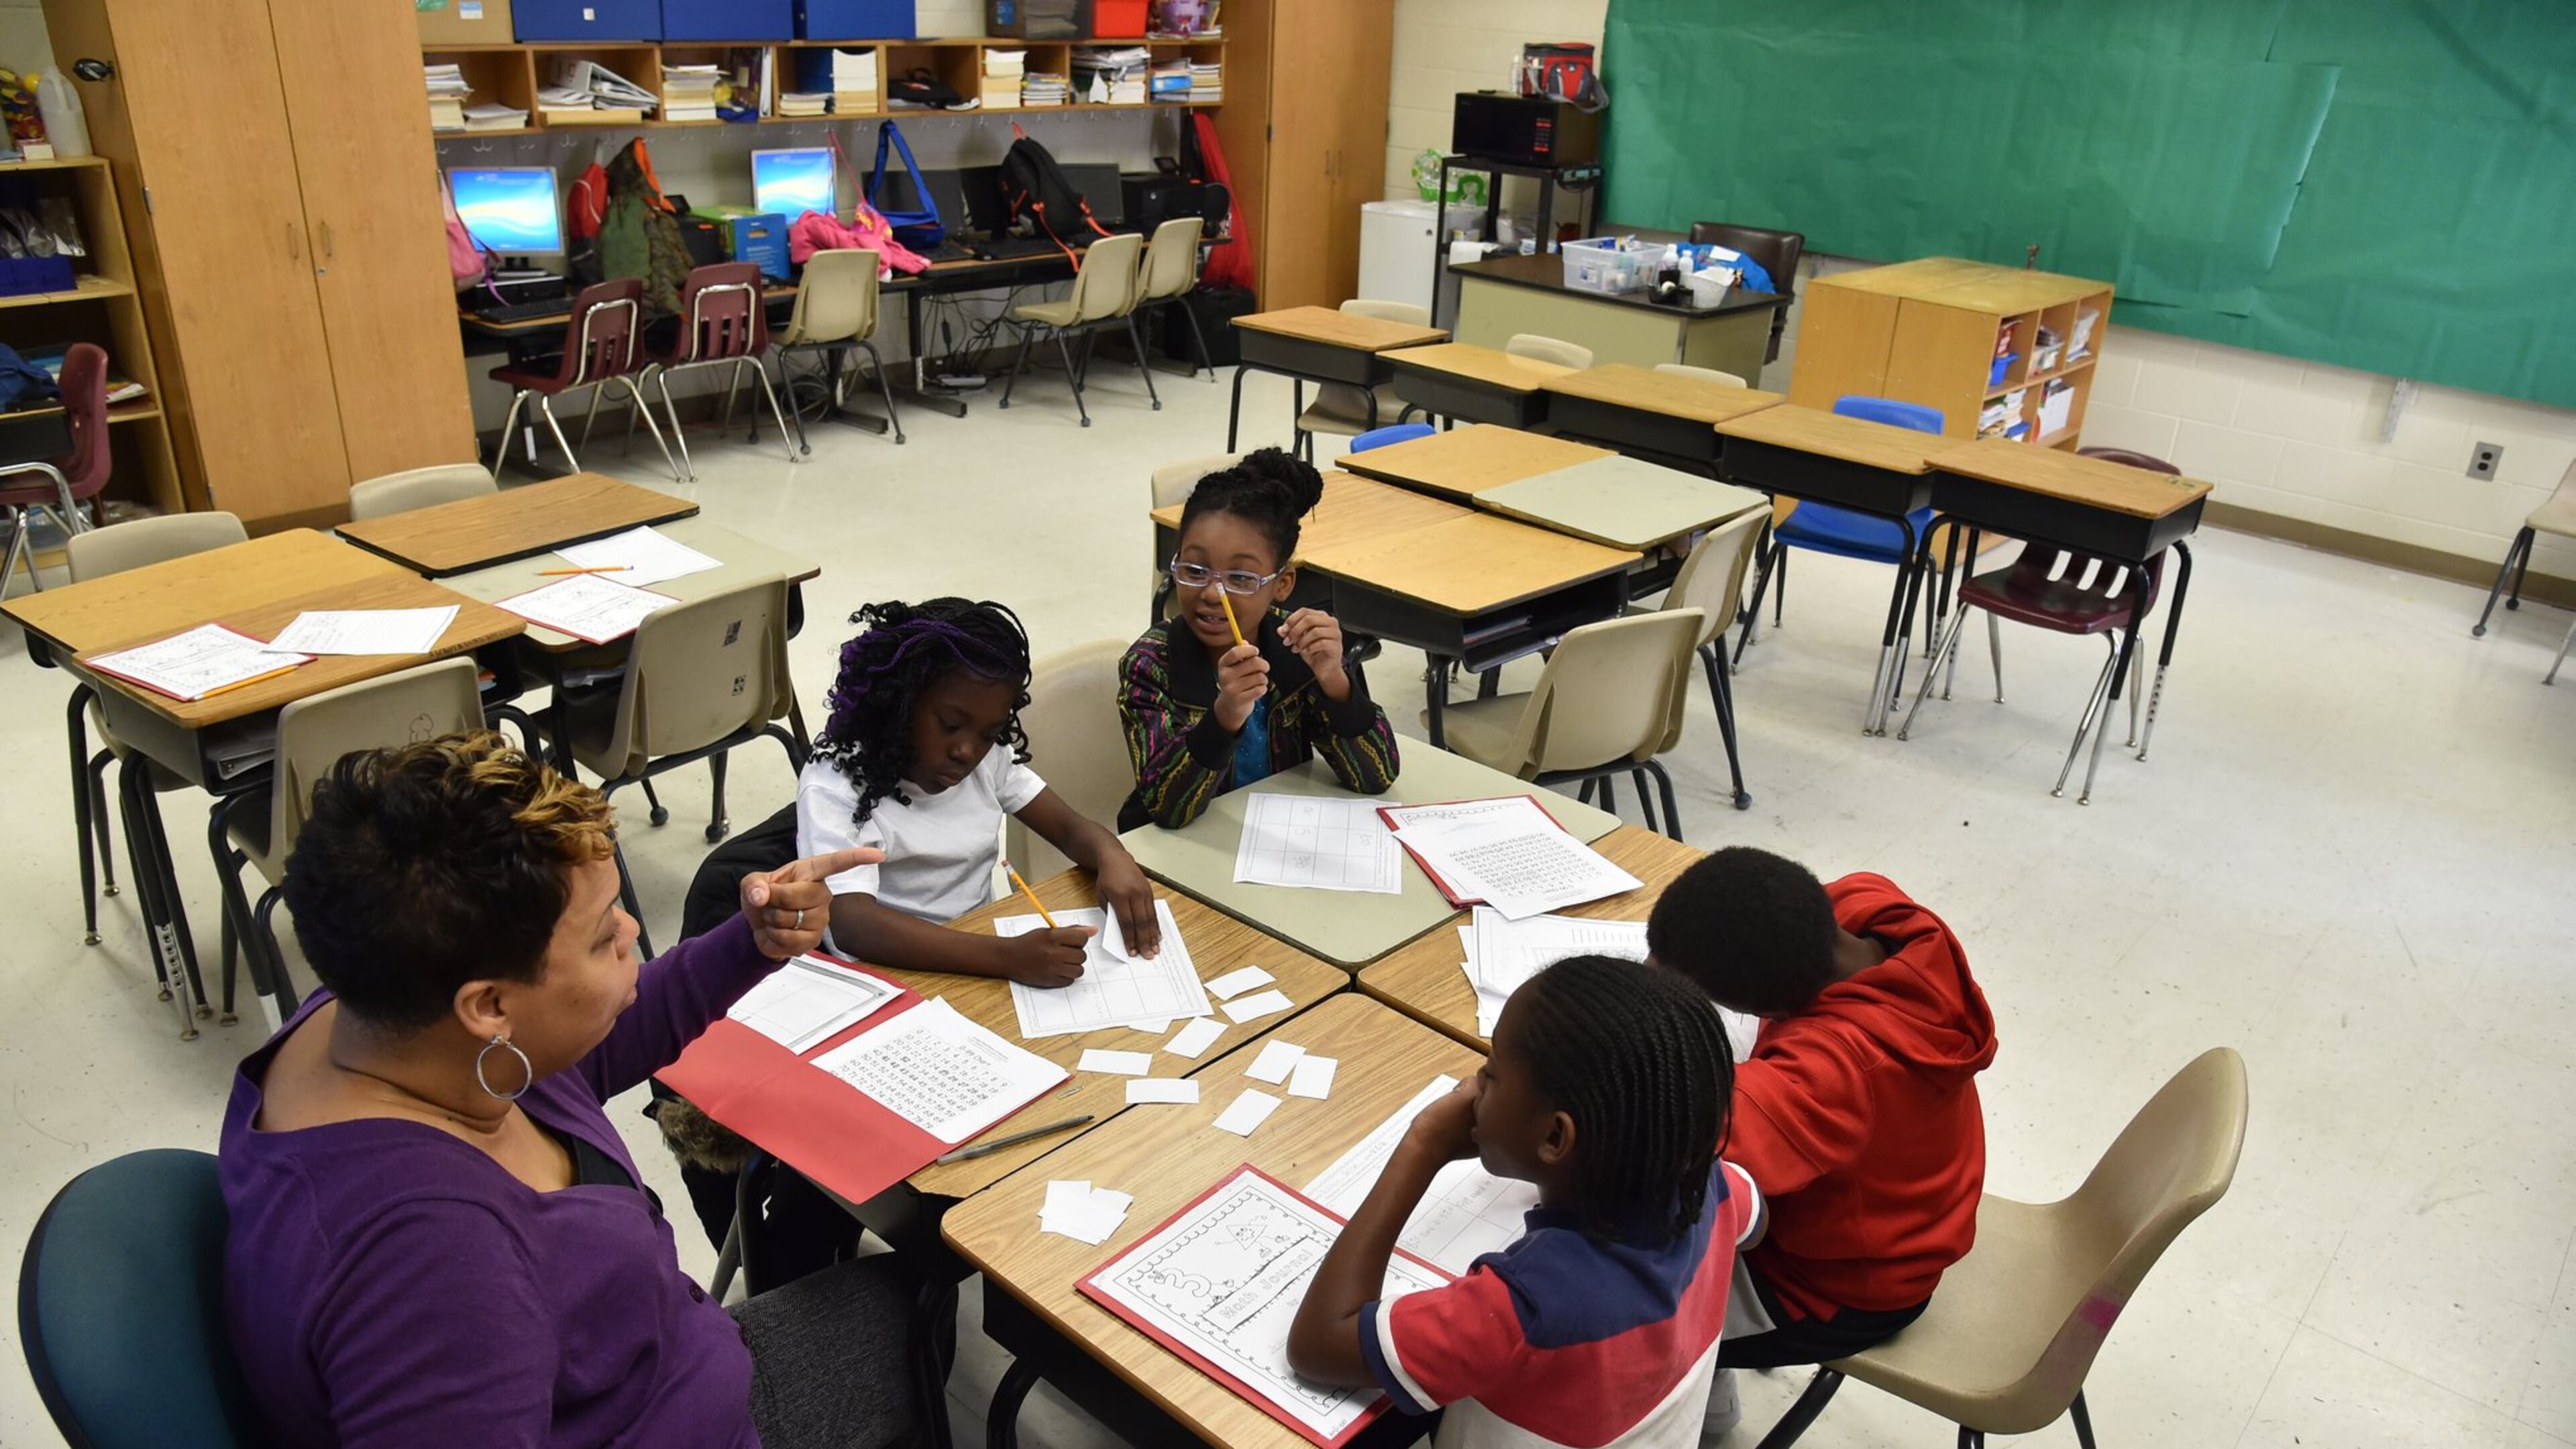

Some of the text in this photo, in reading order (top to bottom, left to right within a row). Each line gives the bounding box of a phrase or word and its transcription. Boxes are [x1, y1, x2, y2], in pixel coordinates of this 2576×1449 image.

[973, 1055, 991, 1066] Chart
[1220, 1248, 1313, 1319] Math Journal
